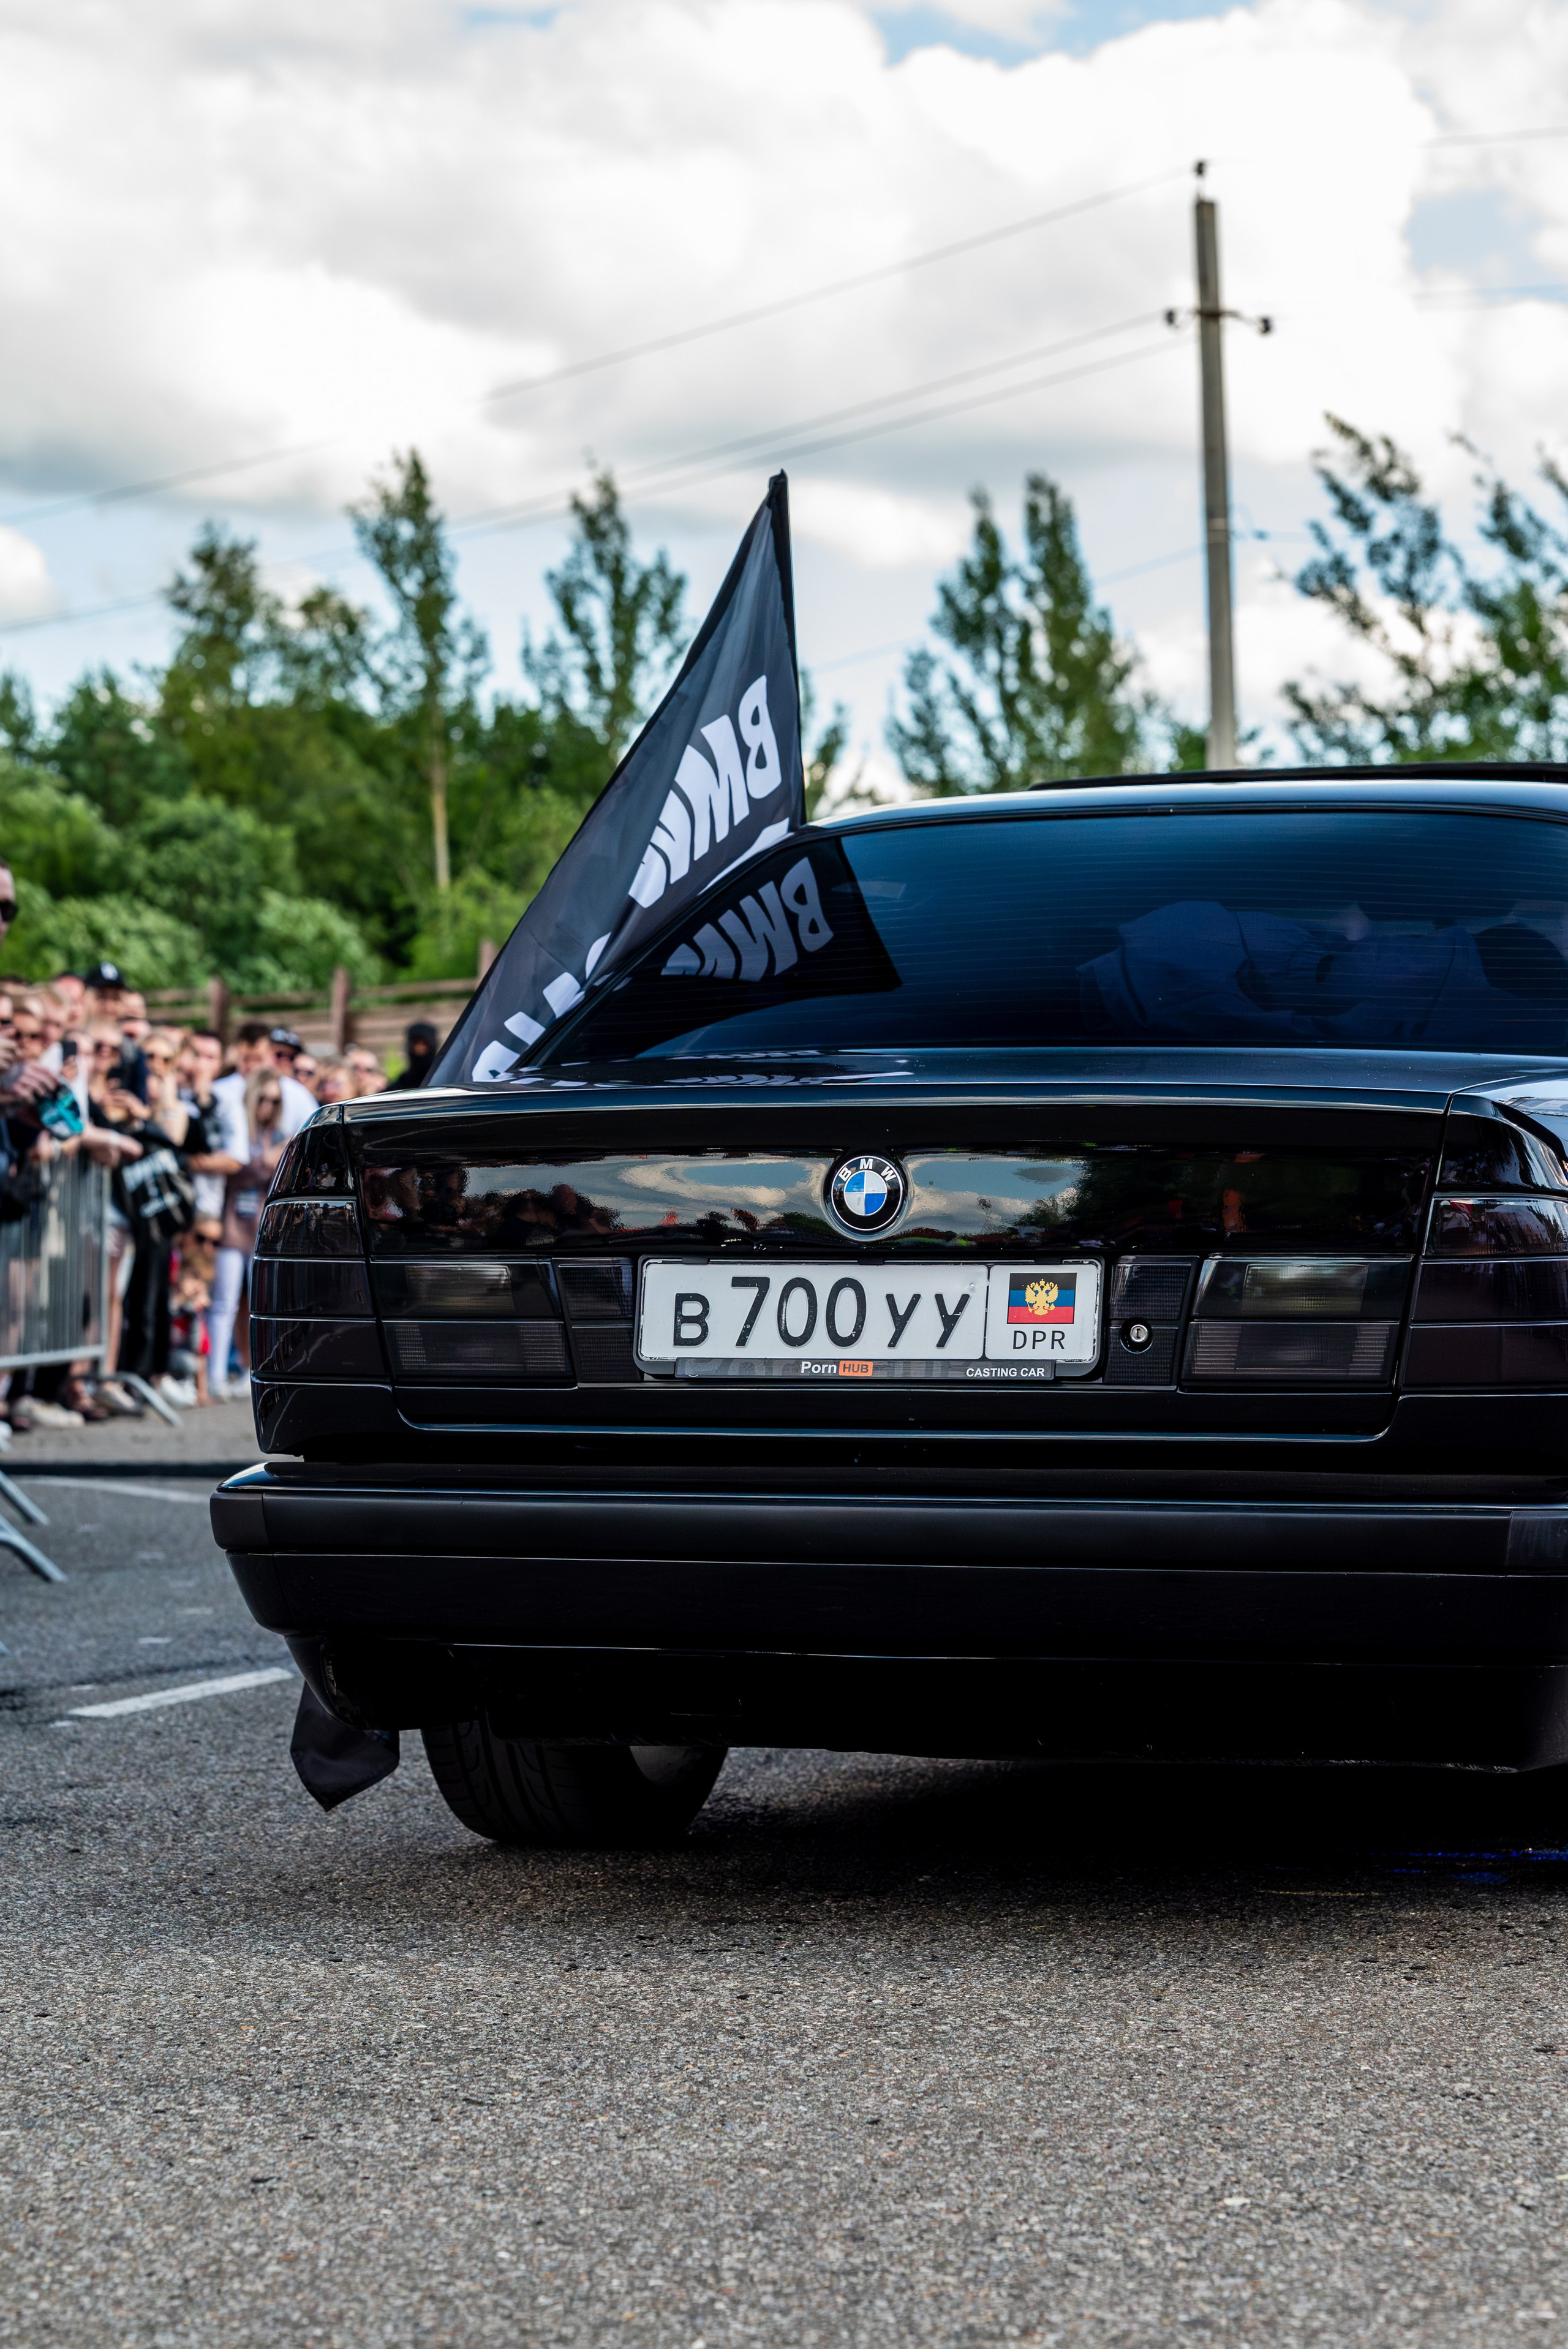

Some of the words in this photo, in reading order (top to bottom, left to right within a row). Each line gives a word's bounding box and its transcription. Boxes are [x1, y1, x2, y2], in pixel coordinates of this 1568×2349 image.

[838, 1158, 897, 1182] BMW
[1012, 1330, 1065, 1349] DPR
[966, 1367, 1017, 1378] CASTING
[1020, 1367, 1045, 1377] CAR
